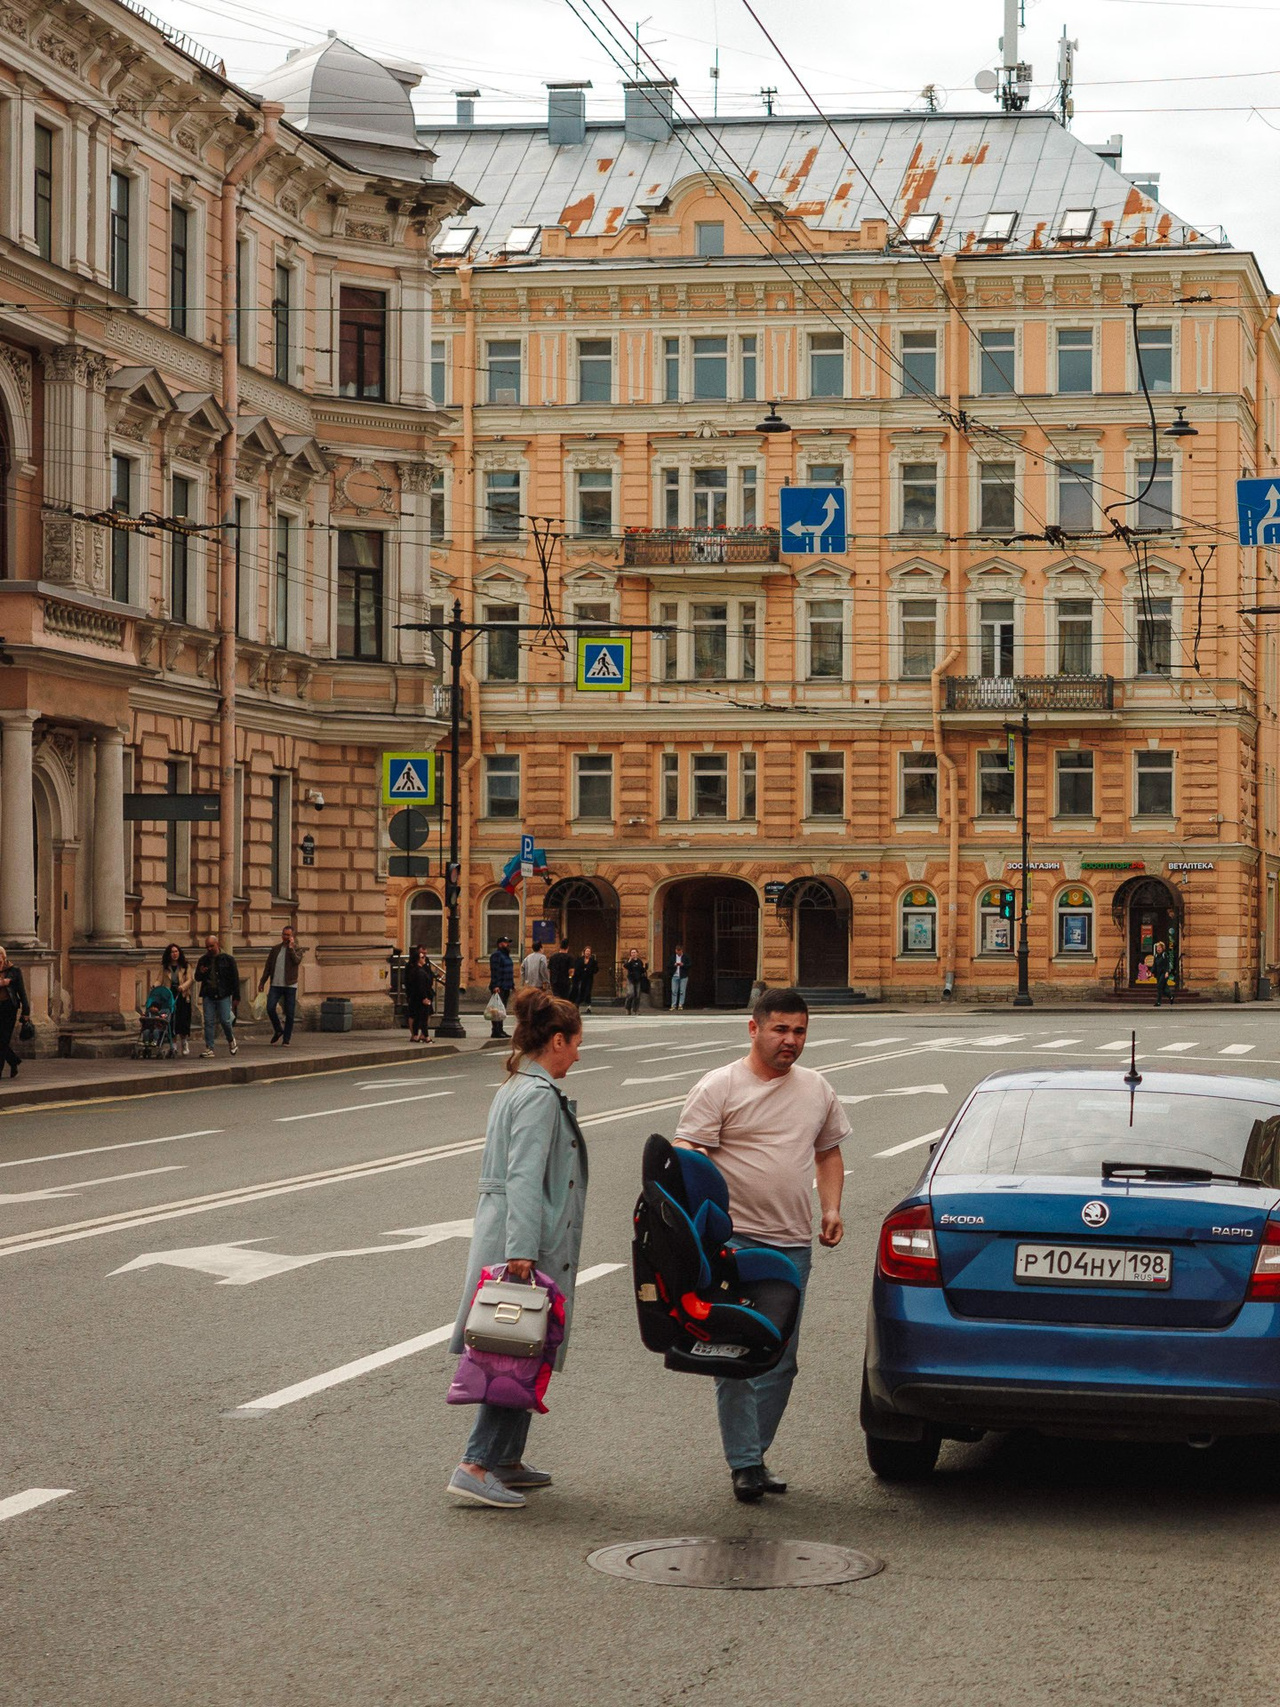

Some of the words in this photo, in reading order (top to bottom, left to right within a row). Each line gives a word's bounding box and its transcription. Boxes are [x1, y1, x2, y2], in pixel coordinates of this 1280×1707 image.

[1006, 862, 1060, 870] ЗООАГАЗИН
[1168, 862, 1214, 870] ВЕТАПТЕКА
[1212, 1226, 1254, 1238] RAPID
[1128, 1254, 1164, 1274] 198
[1134, 1273, 1153, 1281] RUS
